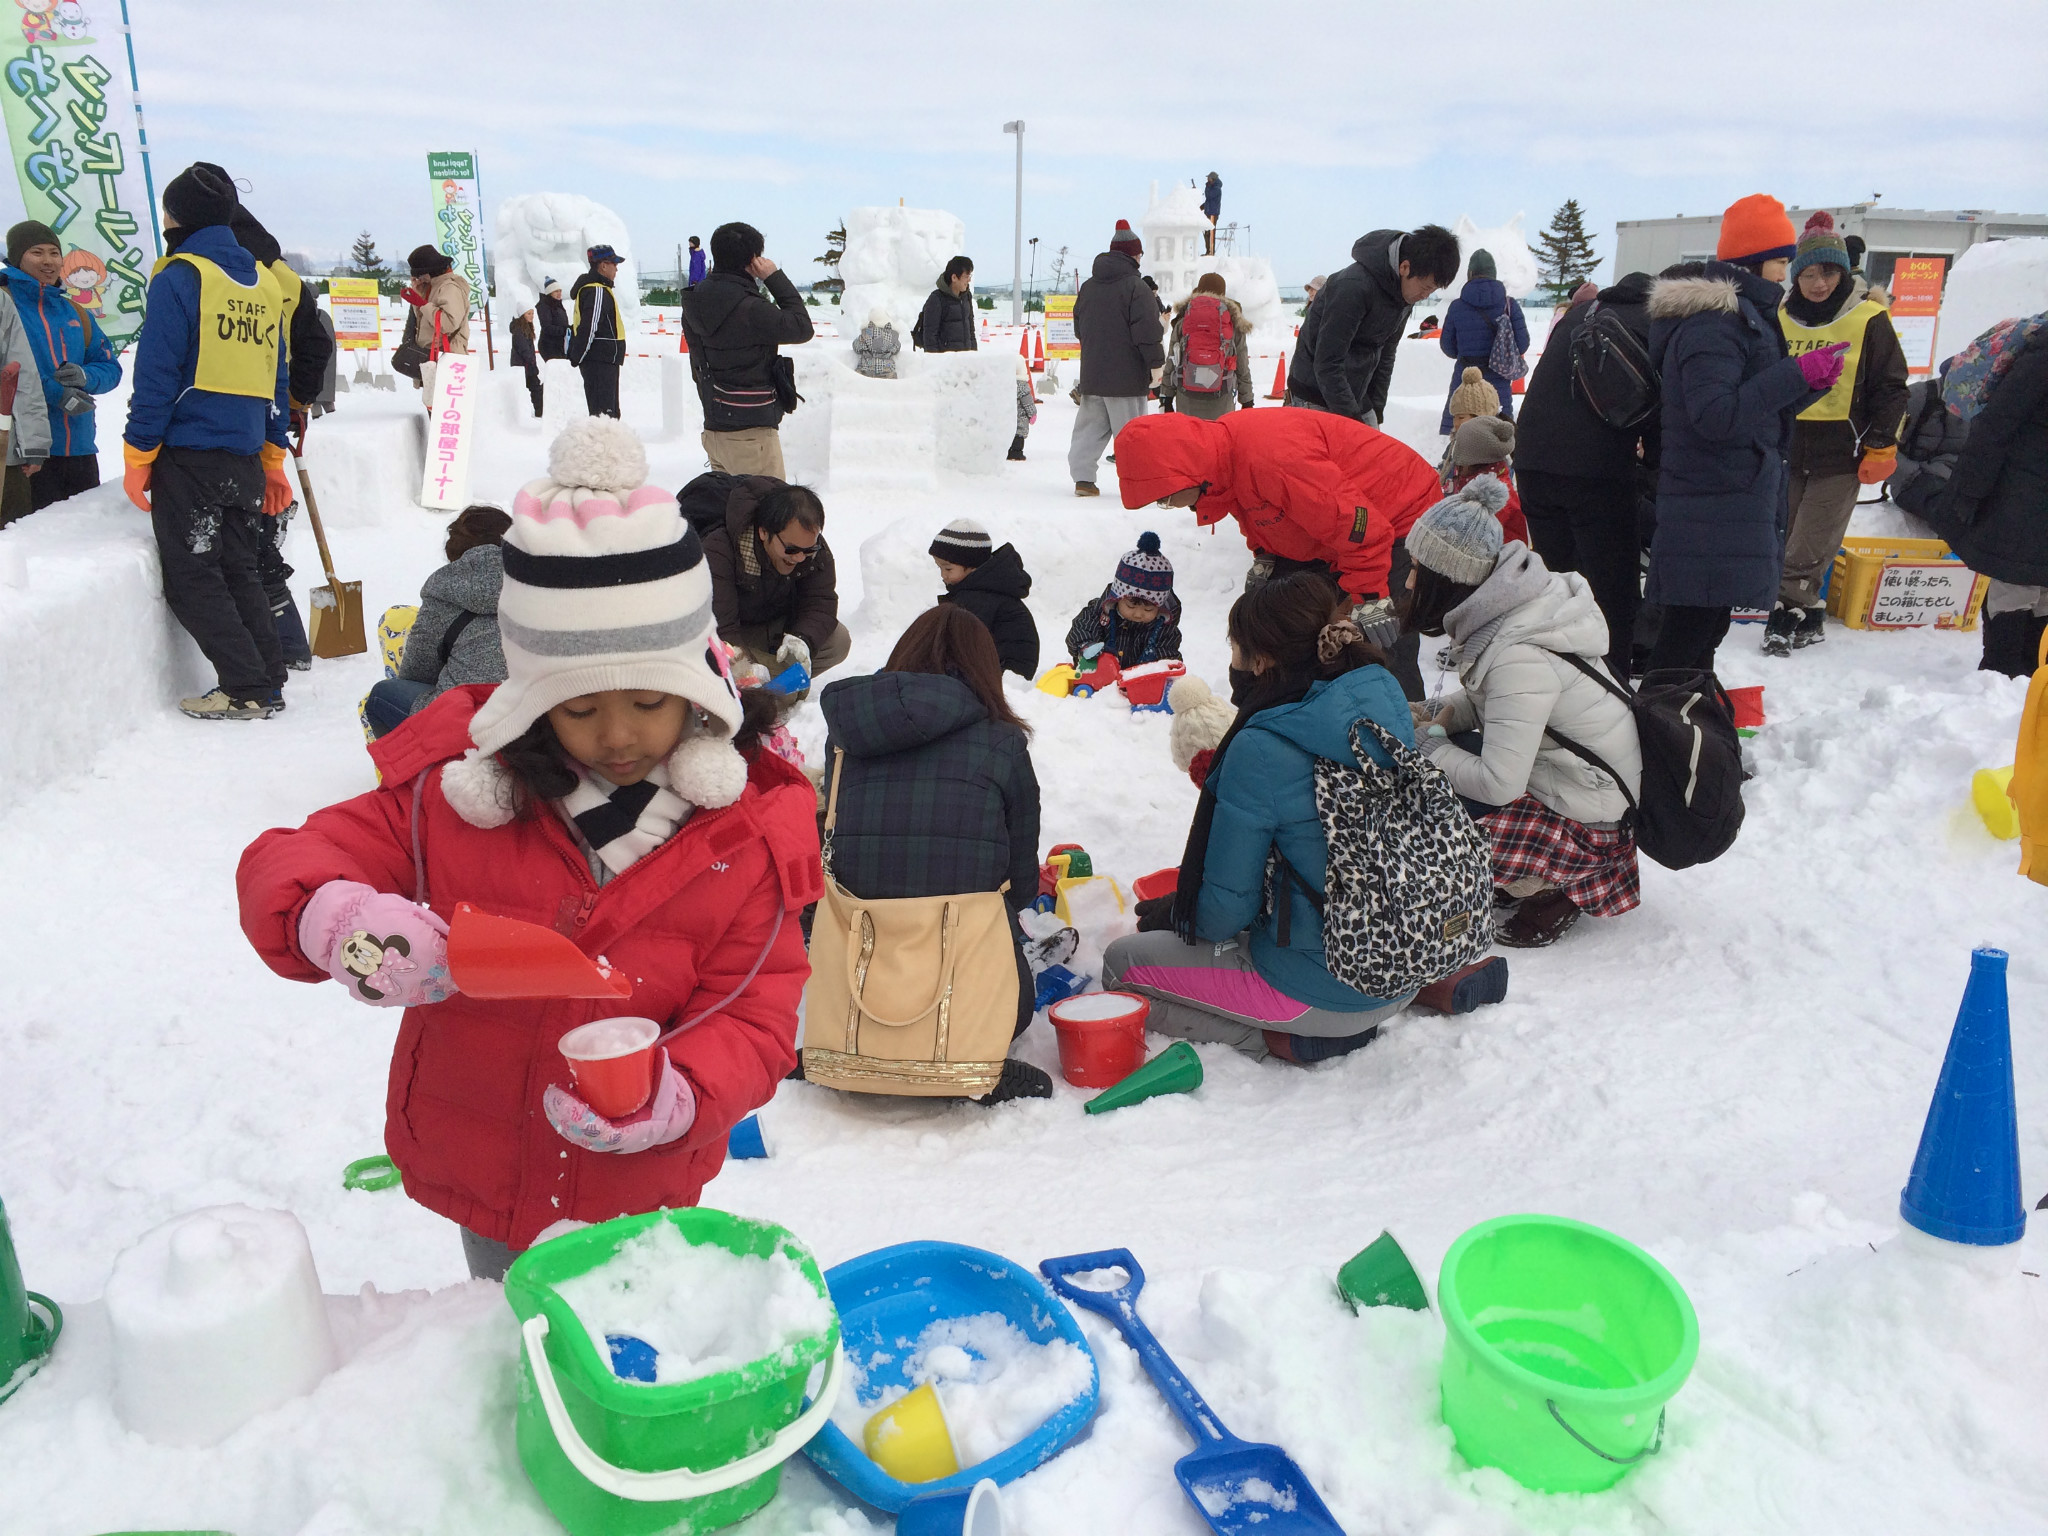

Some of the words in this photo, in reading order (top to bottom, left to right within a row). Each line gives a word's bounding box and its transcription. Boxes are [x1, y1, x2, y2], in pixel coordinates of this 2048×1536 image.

[227, 299, 267, 316] STAFF
[216, 313, 275, 349] ひがしく
[434, 361, 467, 500] タッピーの部屋コーナー
[1878, 596, 1955, 608] この箱にもどし
